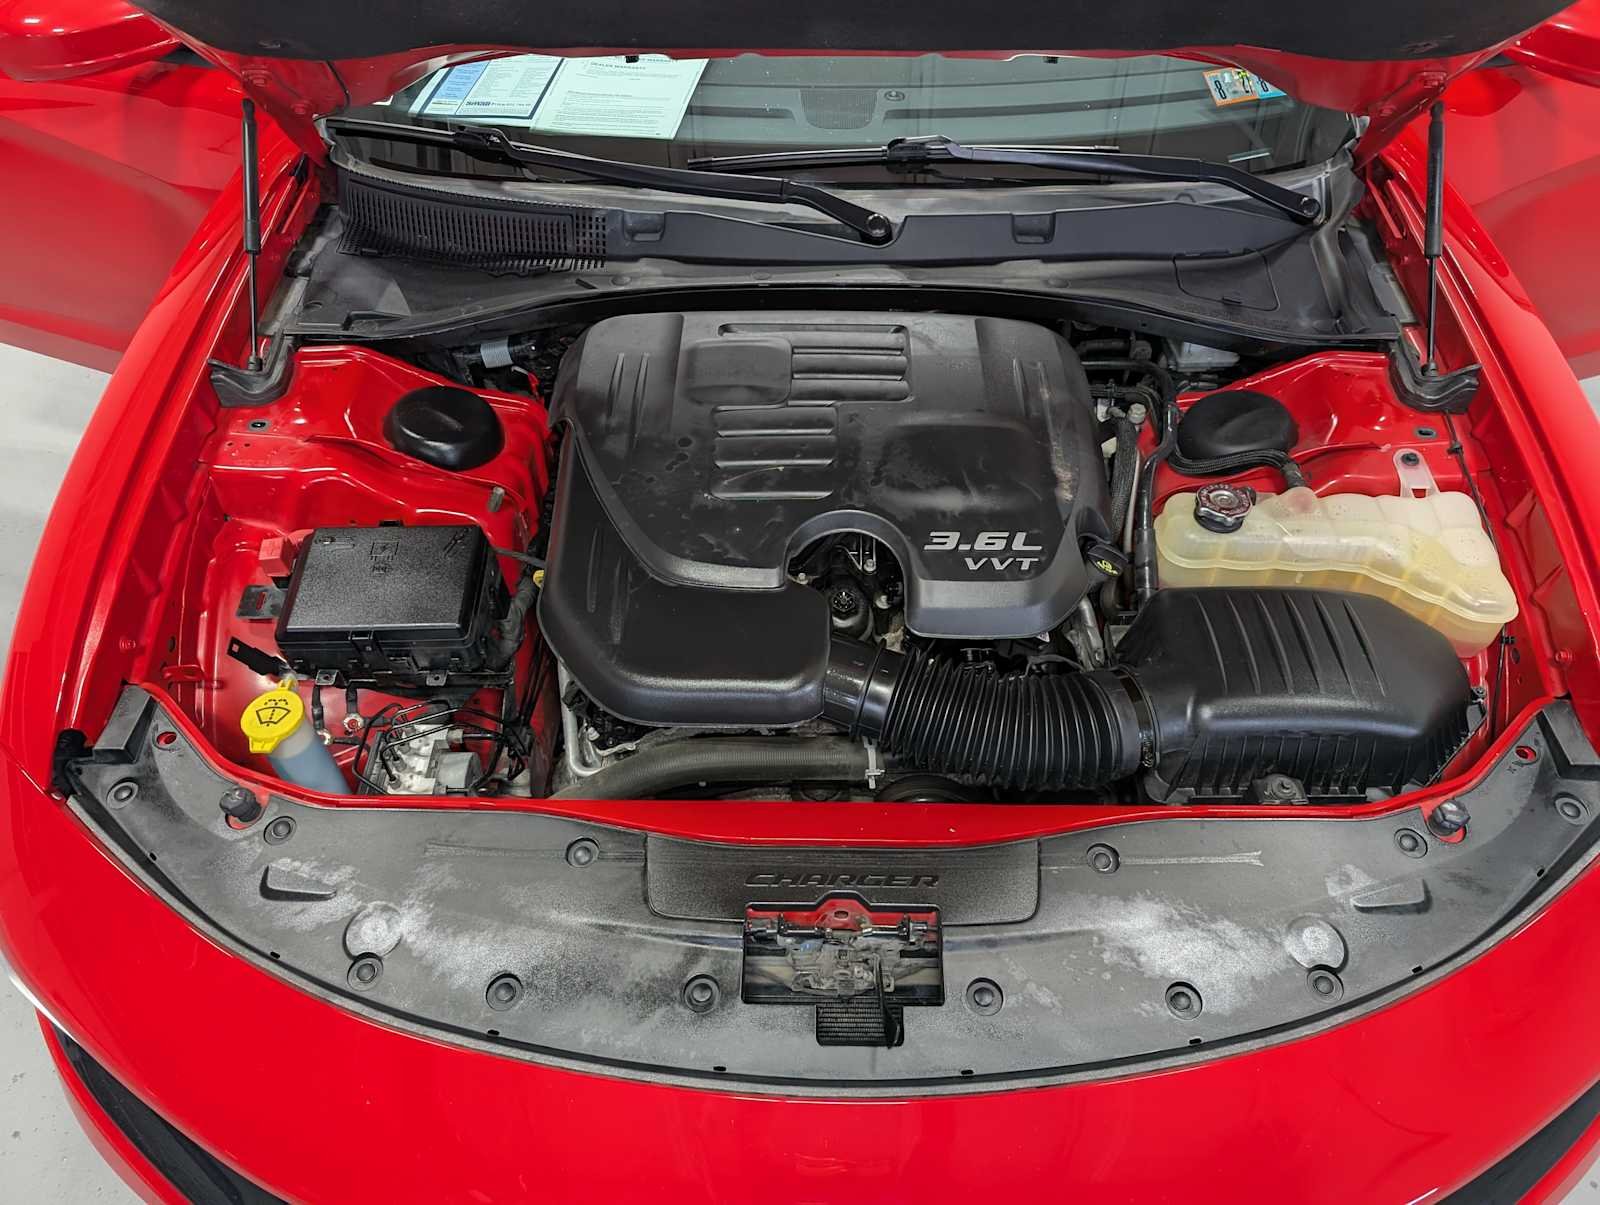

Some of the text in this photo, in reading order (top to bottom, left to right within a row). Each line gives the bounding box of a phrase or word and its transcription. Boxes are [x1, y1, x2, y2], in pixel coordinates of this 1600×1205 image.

[923, 531, 1043, 551] 3.6L
[964, 557, 1040, 571] VVT
[744, 873, 940, 889] CHARGER
